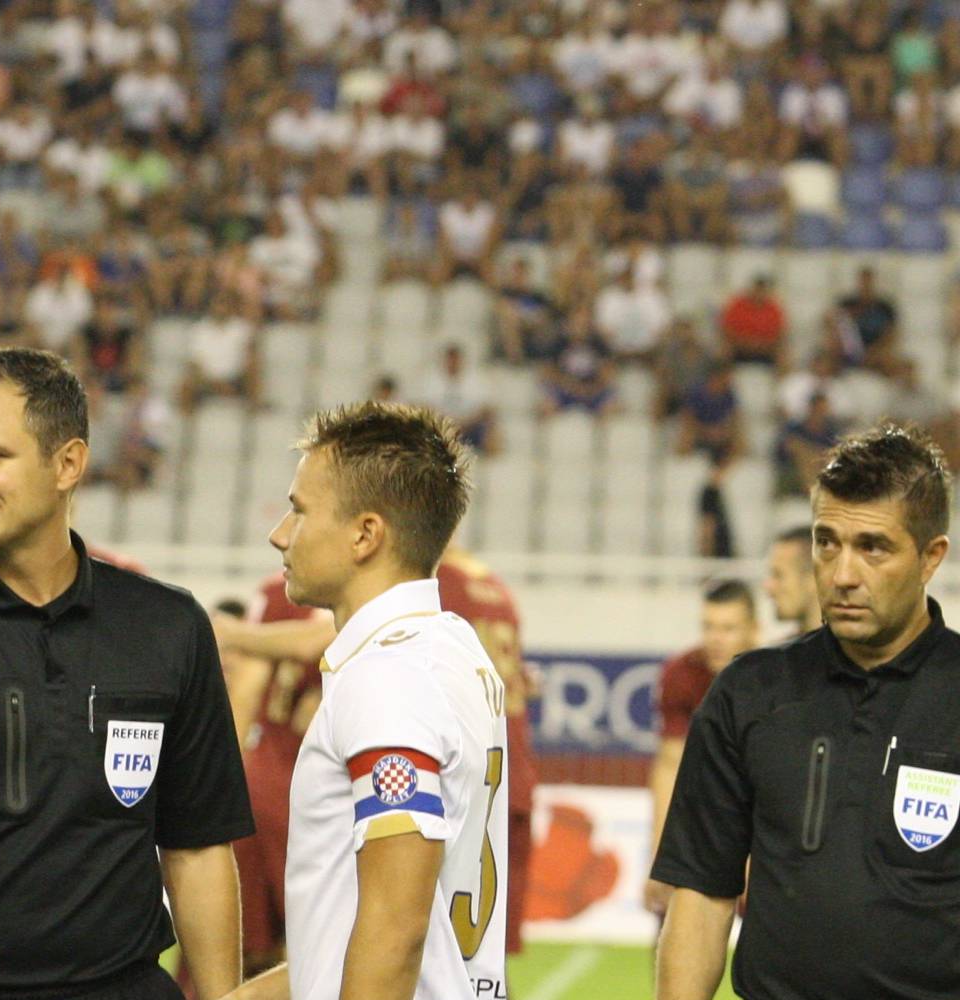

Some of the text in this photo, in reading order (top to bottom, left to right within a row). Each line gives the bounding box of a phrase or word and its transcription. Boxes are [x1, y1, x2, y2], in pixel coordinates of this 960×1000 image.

[112, 727, 160, 740] REFEREE
[112, 753, 152, 772] FIFA
[375, 756, 412, 774] HAJDUK
[121, 789, 139, 800] 2016
[381, 790, 410, 802] SPLIT
[902, 797, 949, 821] FIFA
[909, 833, 933, 845] 2016
